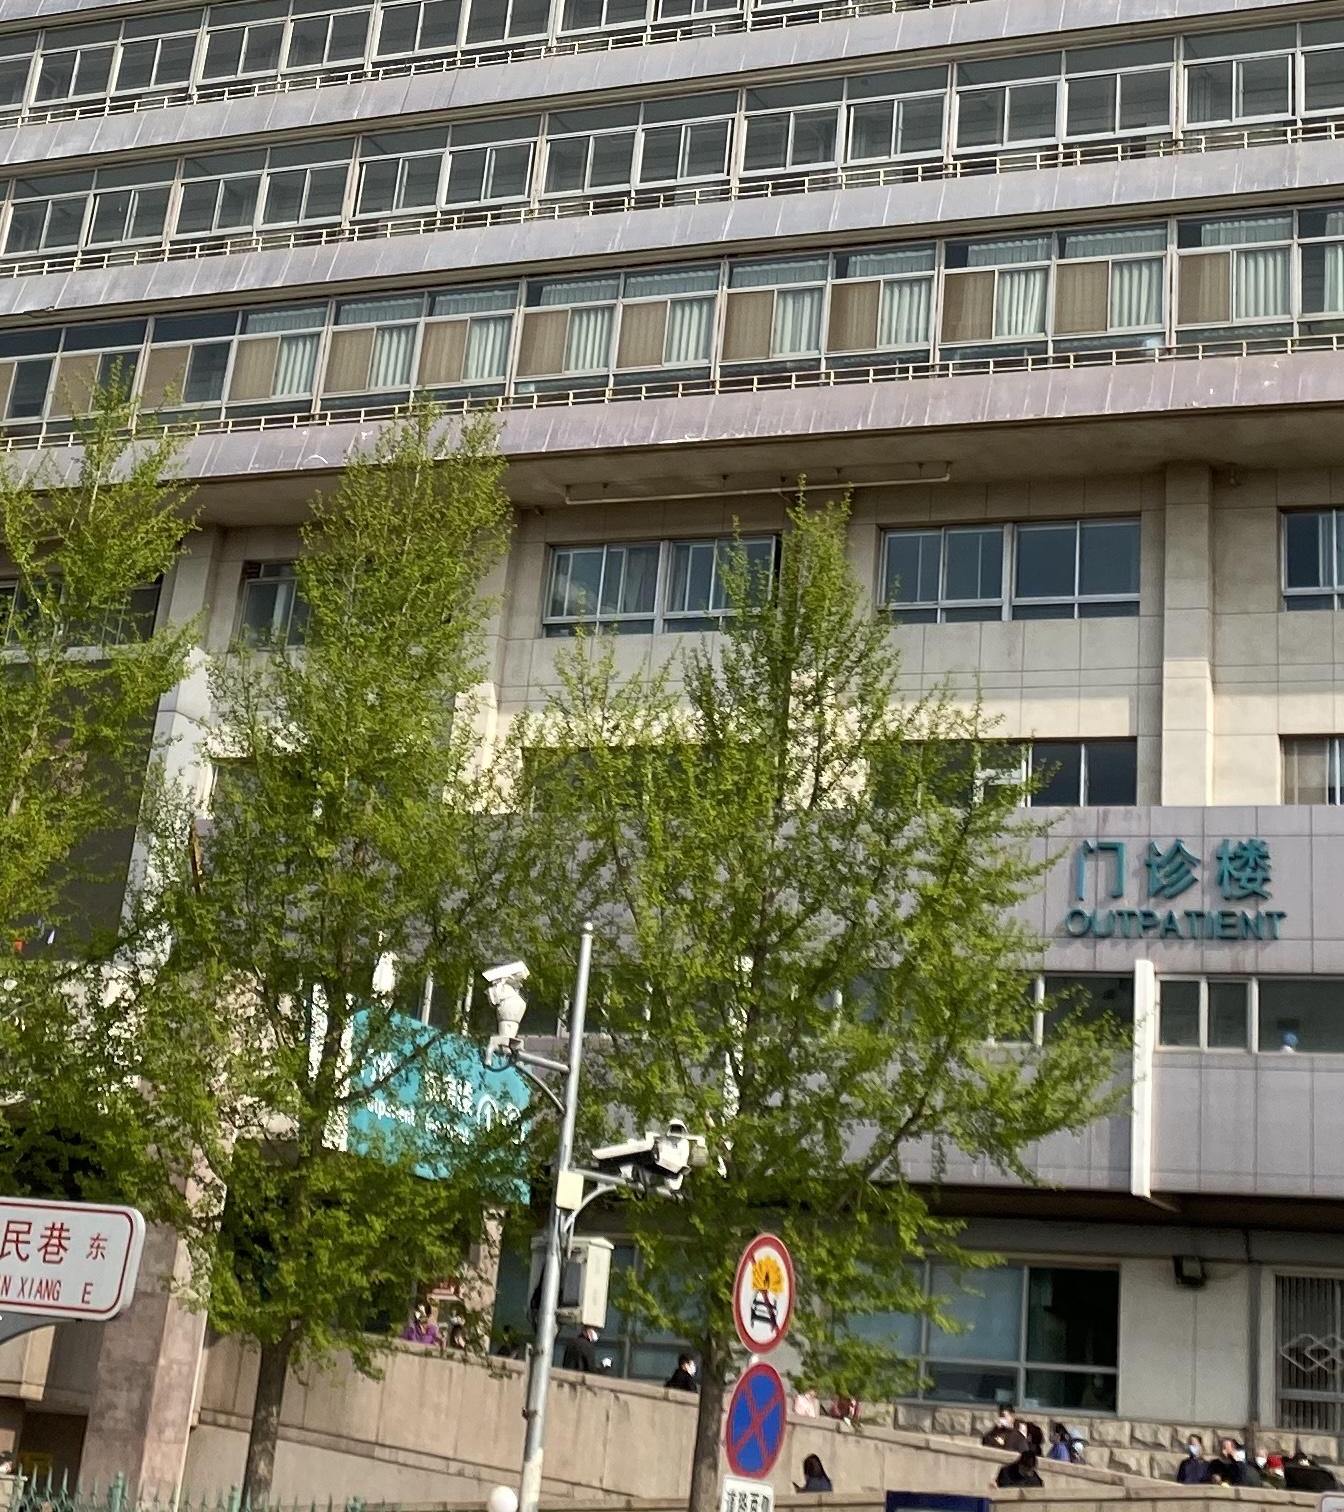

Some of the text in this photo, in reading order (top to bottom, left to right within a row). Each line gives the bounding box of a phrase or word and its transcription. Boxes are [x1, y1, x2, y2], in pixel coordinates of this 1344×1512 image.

[1076, 838, 1272, 901] 门诊楼
[1066, 909, 1287, 940] OUTPATIENT
[86, 1233, 107, 1261] 东
[18, 1276, 62, 1302] XIANG
[81, 1282, 94, 1305] E
